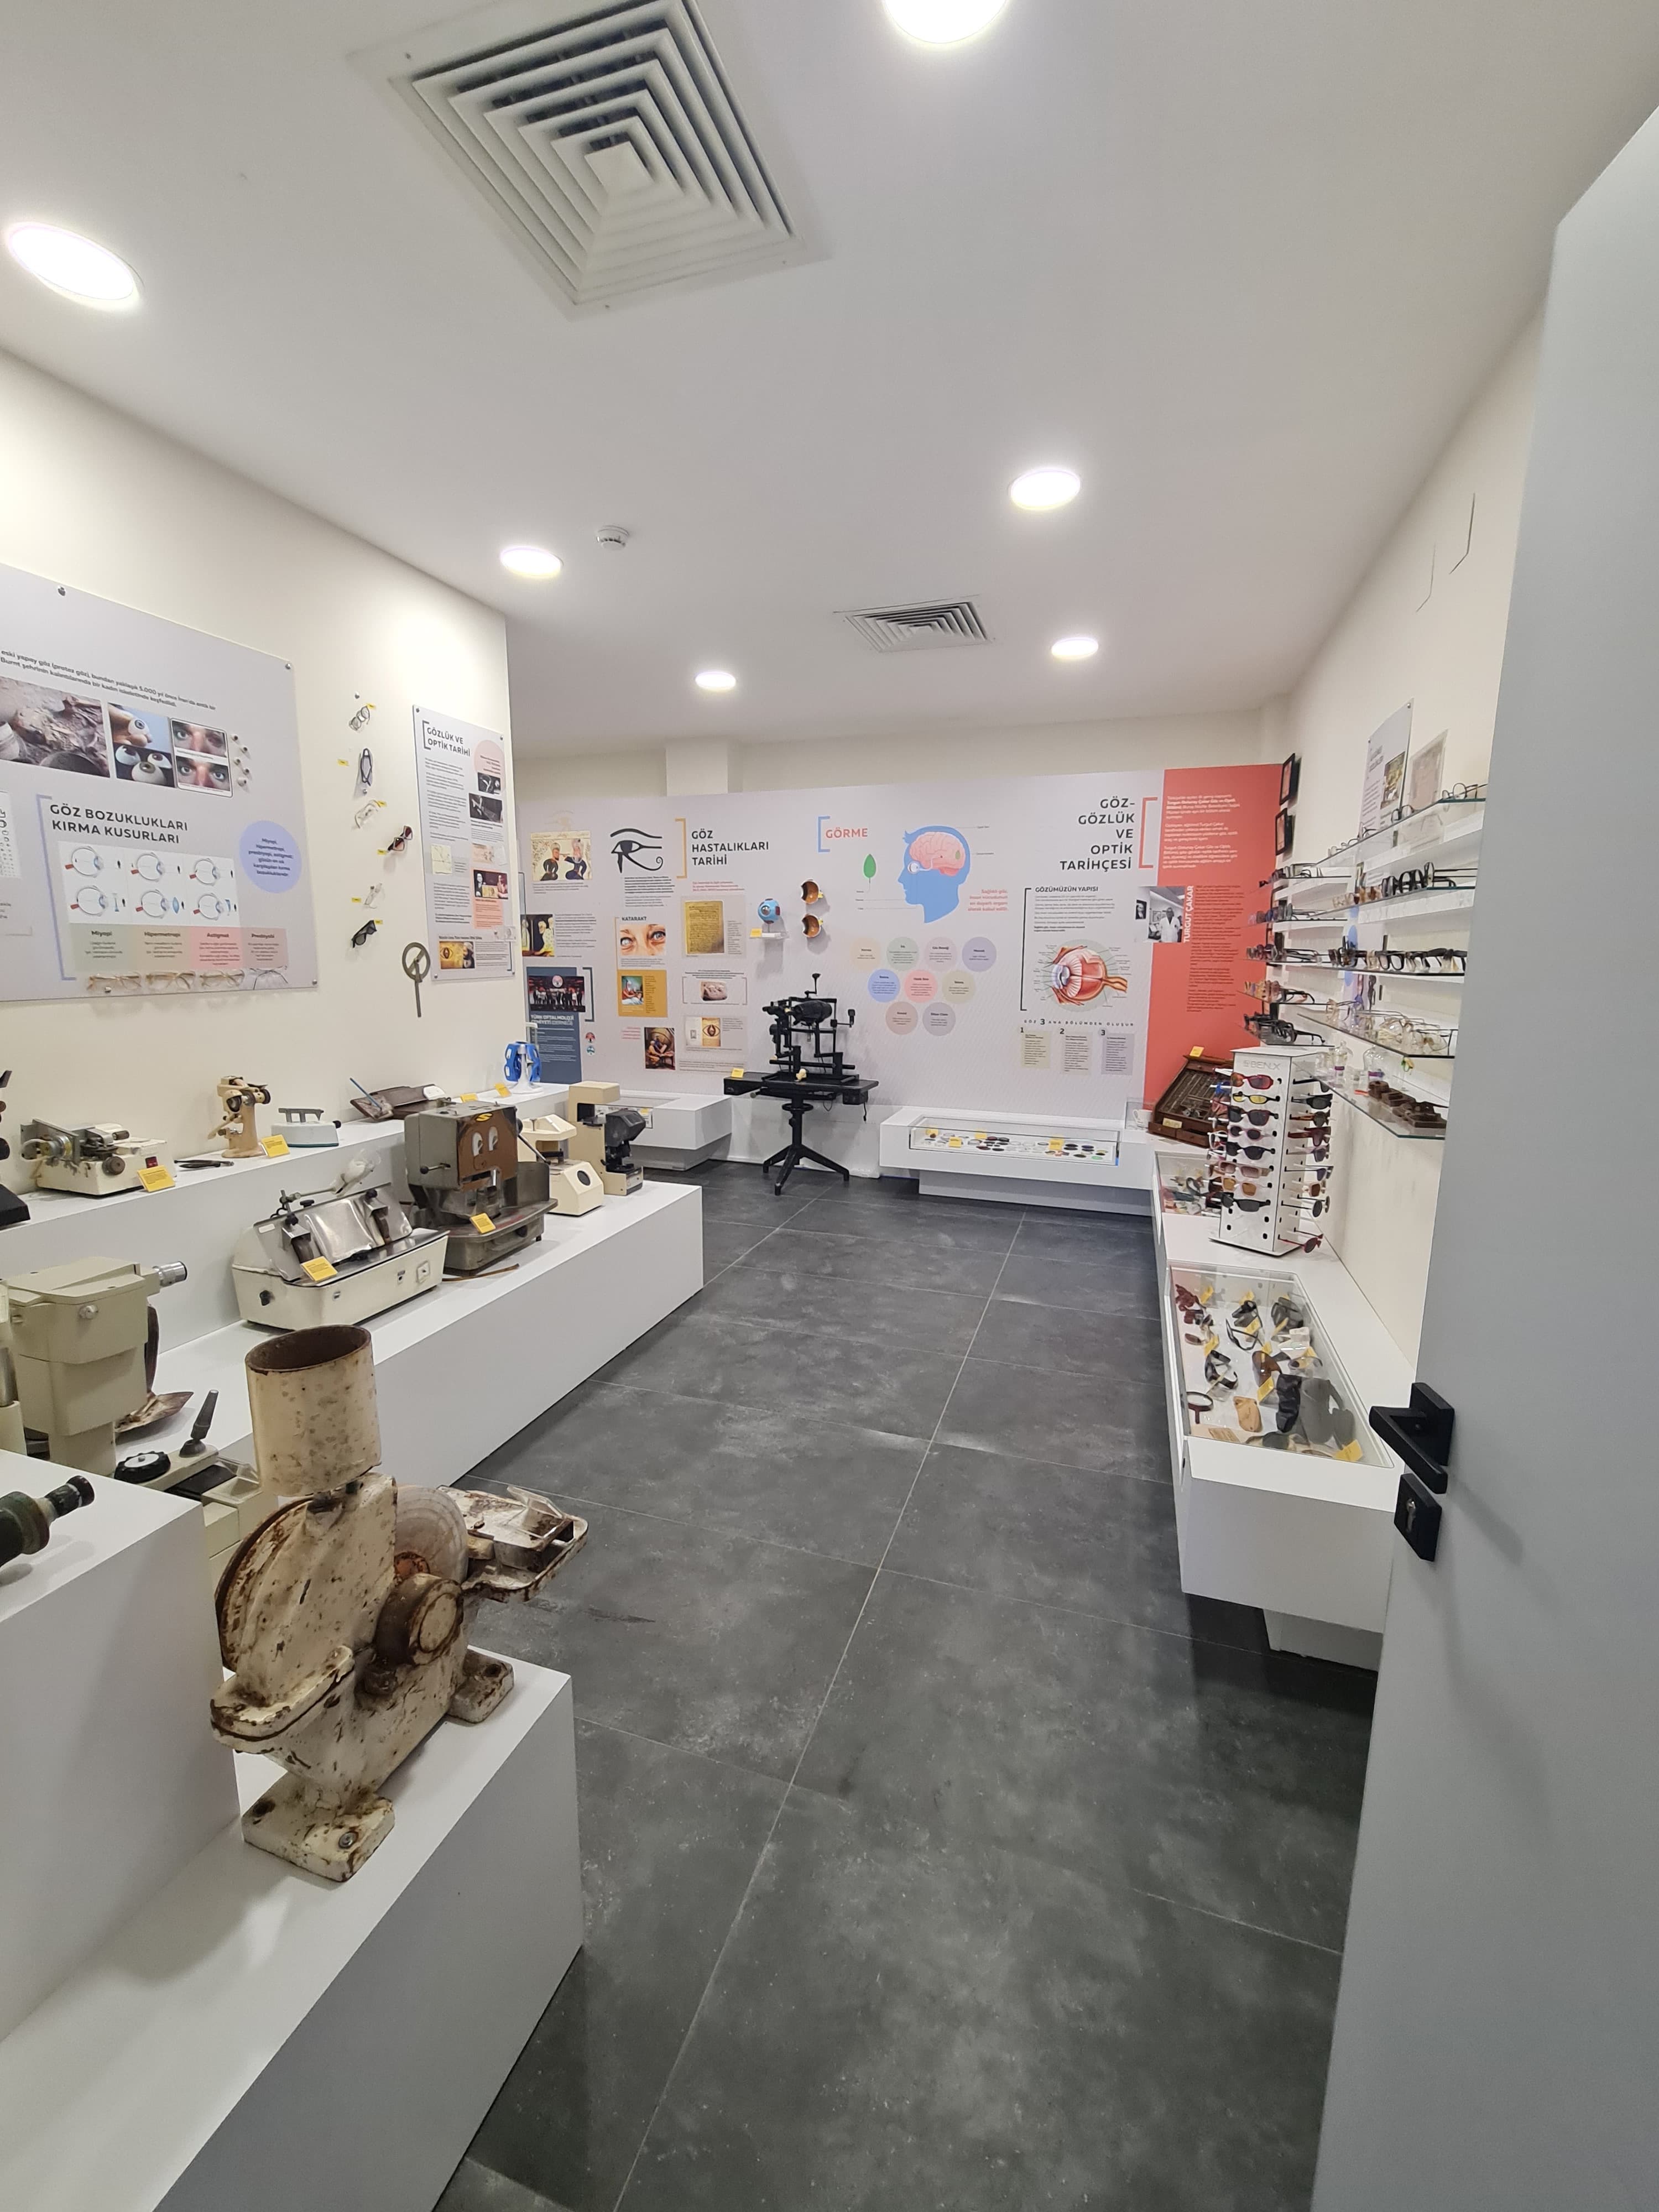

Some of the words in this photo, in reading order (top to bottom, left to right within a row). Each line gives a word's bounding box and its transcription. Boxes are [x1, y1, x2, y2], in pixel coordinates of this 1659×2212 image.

[427, 727, 454, 742] GÖZLÜK
[455, 735, 464, 744] VE
[427, 738, 448, 750] OPTİK
[449, 744, 471, 757] TARİHİ
[1100, 796, 1135, 809] GÖZ-
[50, 803, 82, 817] GÖZ
[85, 808, 188, 831] BOZUKLUKLARI
[1078, 811, 1135, 825] GÖZLÜK
[52, 820, 101, 835] KIRMA
[104, 826, 180, 844] KUSURLARI
[691, 828, 713, 839] GÖZ
[826, 827, 868, 838] GÖRME
[1115, 828, 1134, 839] VE
[692, 841, 769, 853] HASTALIKLARI
[1091, 841, 1133, 855] OPTİK
[692, 854, 727, 866] TARİHİ
[1060, 857, 1131, 873] TARİHÇESİ
[1186, 885, 1194, 912] ÇAKAR
[1183, 912, 1192, 943] TURGUT
